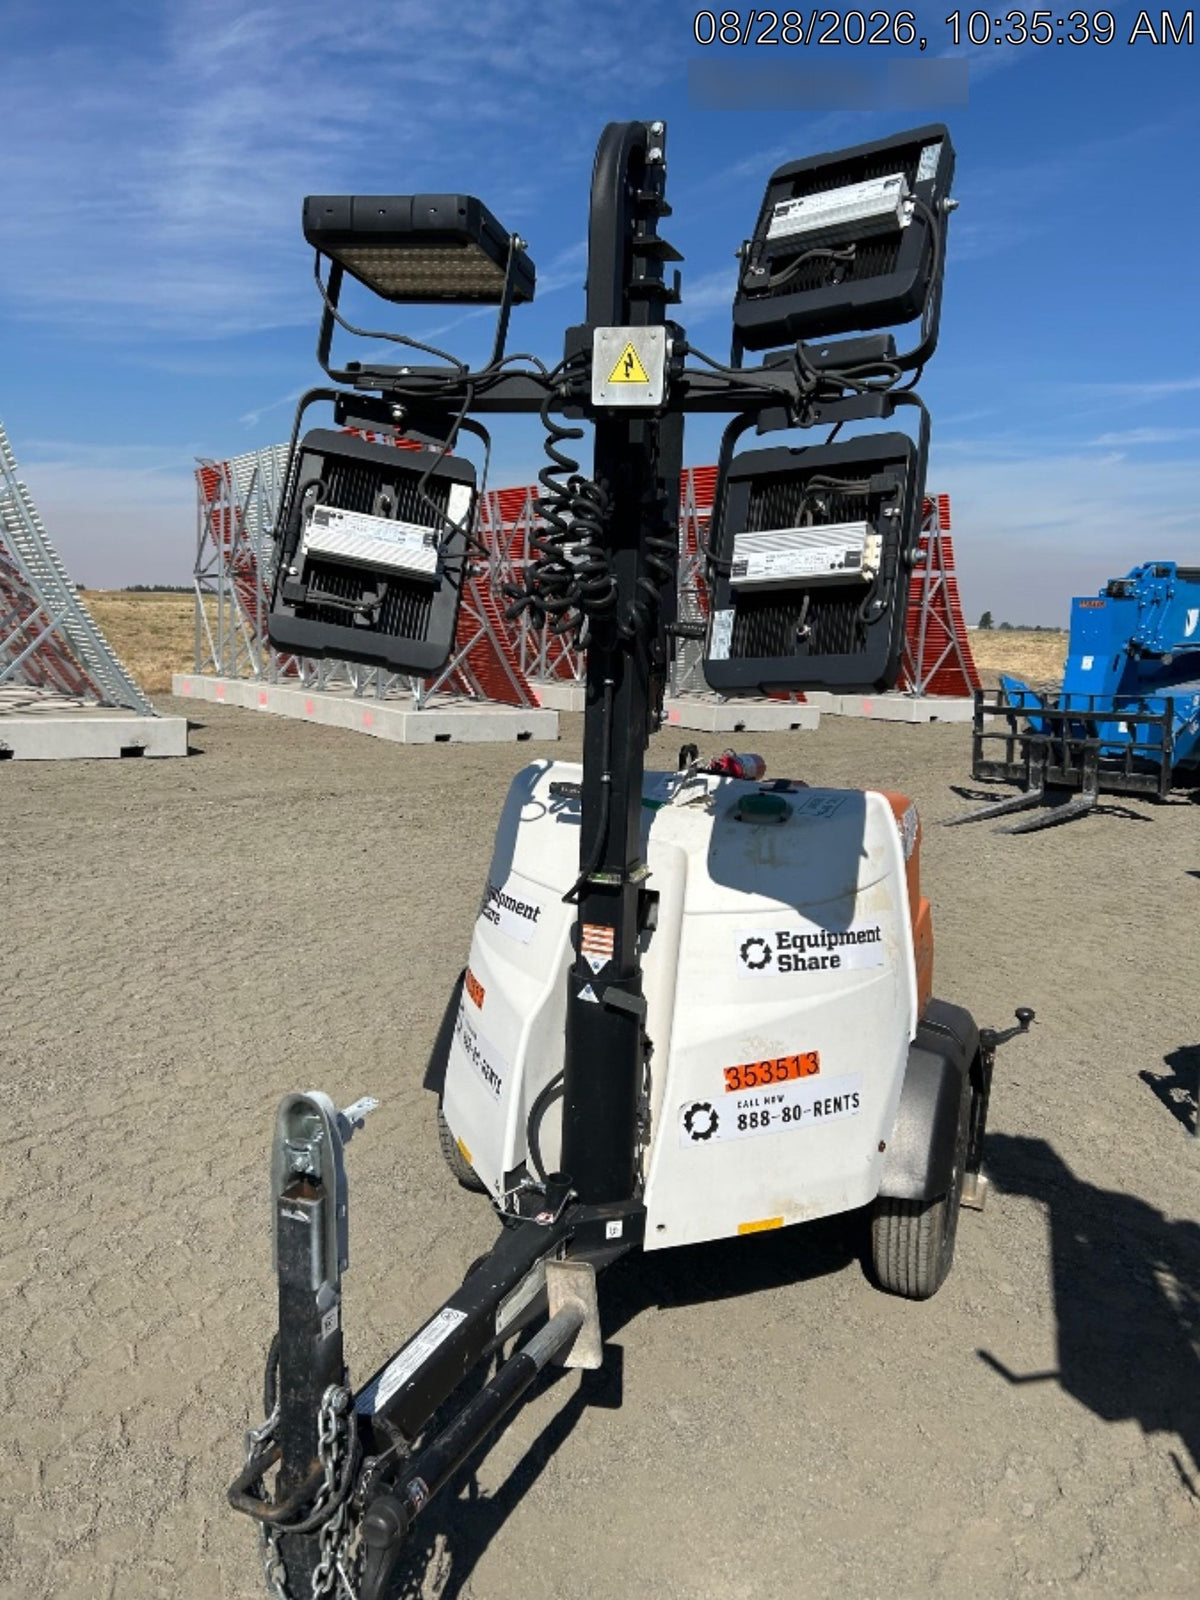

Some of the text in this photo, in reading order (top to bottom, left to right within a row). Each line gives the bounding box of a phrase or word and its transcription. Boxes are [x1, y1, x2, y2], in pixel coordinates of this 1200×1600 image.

[776, 926, 881, 950] Equipment
[778, 954, 841, 973] Share
[726, 1052, 820, 1090] 353513
[737, 1098, 760, 1109] CALL
[737, 1092, 860, 1131] 888-80-RENTS
